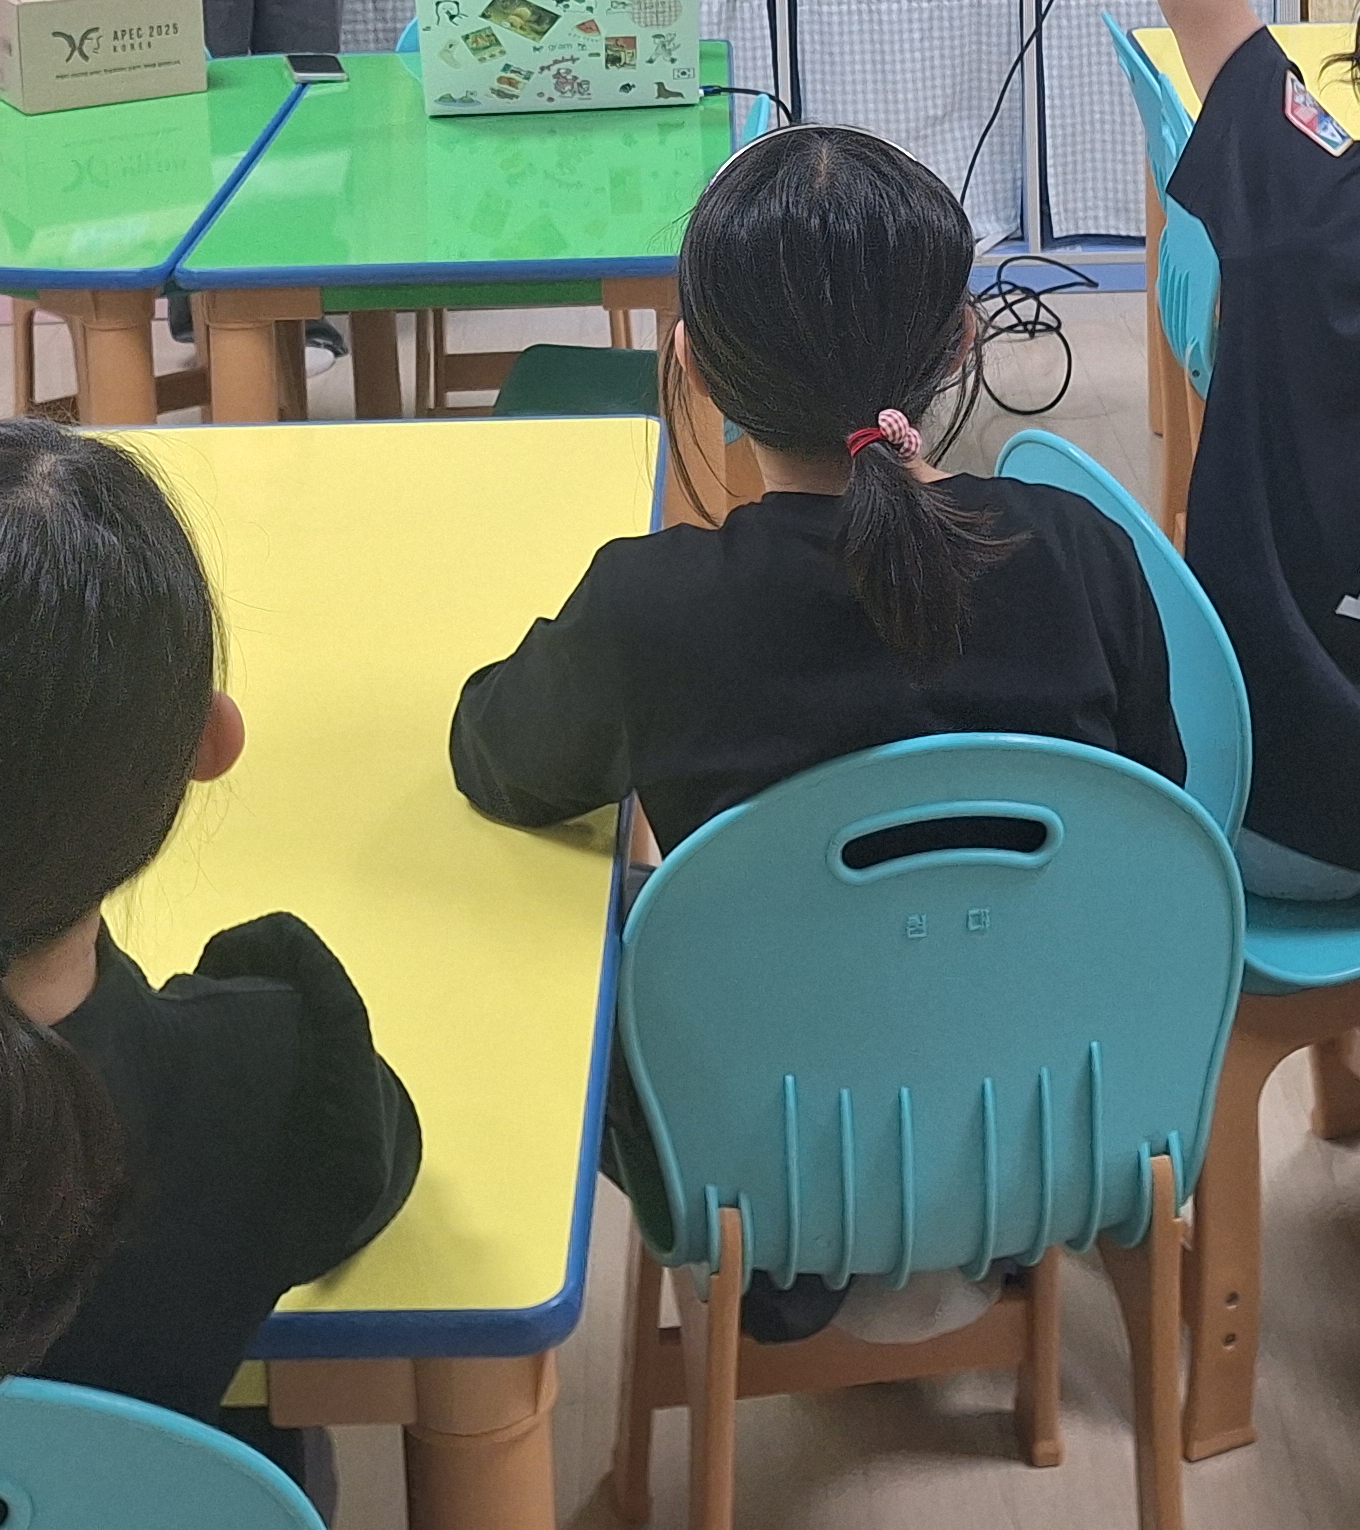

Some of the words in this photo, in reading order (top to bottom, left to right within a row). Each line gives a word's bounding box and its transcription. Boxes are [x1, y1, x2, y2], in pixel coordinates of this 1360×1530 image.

[112, 26, 143, 42] APEC
[148, 22, 180, 38] 2025
[112, 41, 152, 54] KOREA
